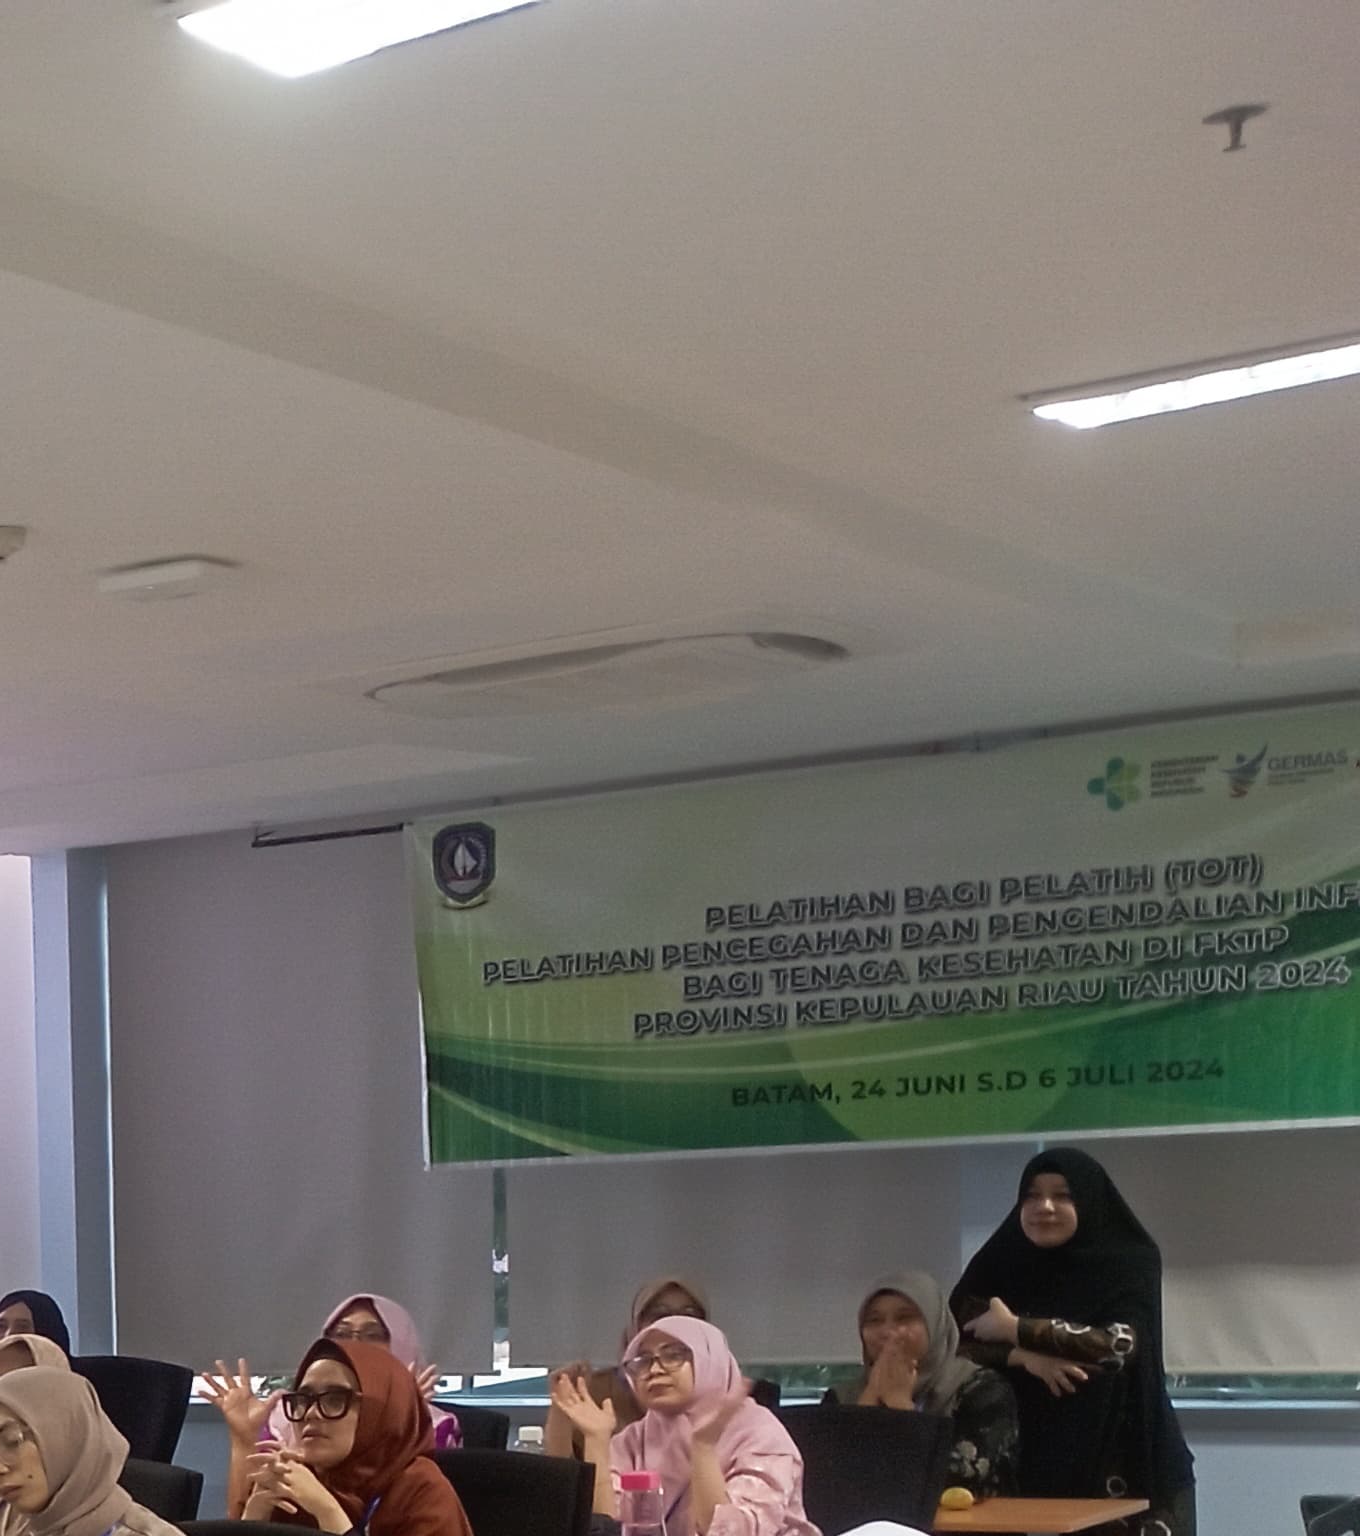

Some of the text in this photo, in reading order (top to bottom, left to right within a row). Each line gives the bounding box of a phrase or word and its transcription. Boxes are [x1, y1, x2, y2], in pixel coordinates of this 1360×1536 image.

[1267, 750, 1348, 771] GERMAS
[705, 853, 1265, 933] PELATIHAN BAGI PELATIH (TOT)
[483, 947, 654, 985] PELATIHAN
[661, 924, 890, 969] PENCEGAHAN
[901, 917, 977, 949] DAN
[988, 892, 1284, 939] PENGENDALIAN
[683, 924, 1289, 1001] BAGI TENAGA KESEHATAN DI FKTP
[633, 956, 1351, 1039] PROVINSI KEPULAUAN RIAU TAHUN 2024
[731, 1058, 1225, 1106] BATAM, 24 JUNI S.D 6 JULI 2024
